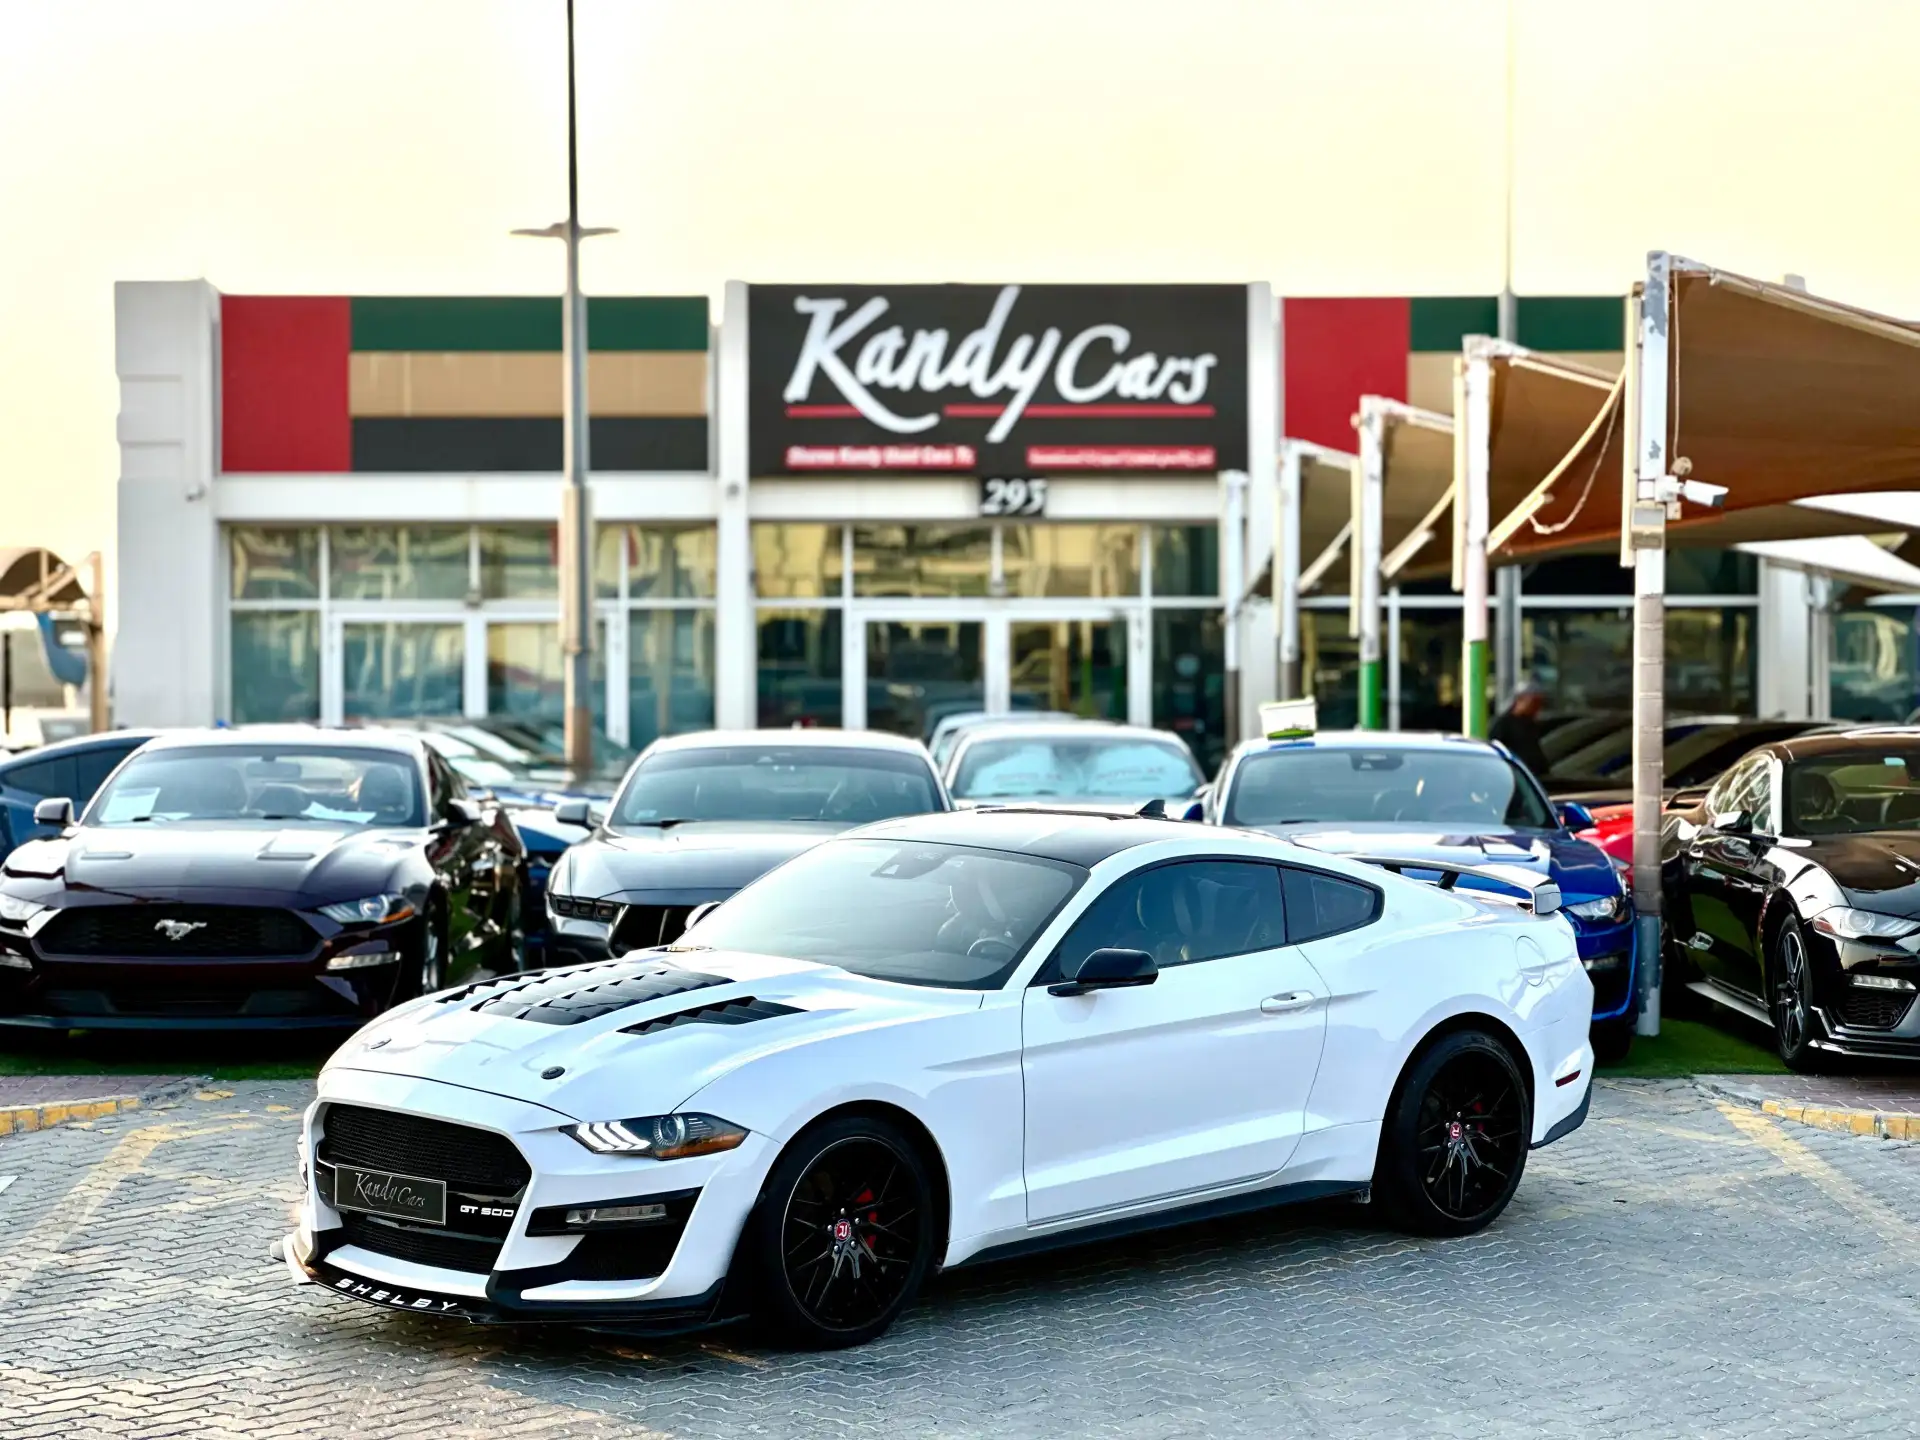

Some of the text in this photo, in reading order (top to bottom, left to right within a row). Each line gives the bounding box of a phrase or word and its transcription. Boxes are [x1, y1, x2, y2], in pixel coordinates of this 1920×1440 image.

[783, 285, 1217, 443] Kandy Cars
[980, 478, 1048, 515] 295
[353, 1172, 425, 1209] Kandy Cars
[460, 1205, 514, 1217] GT 500
[335, 1278, 457, 1311] SHELBY
